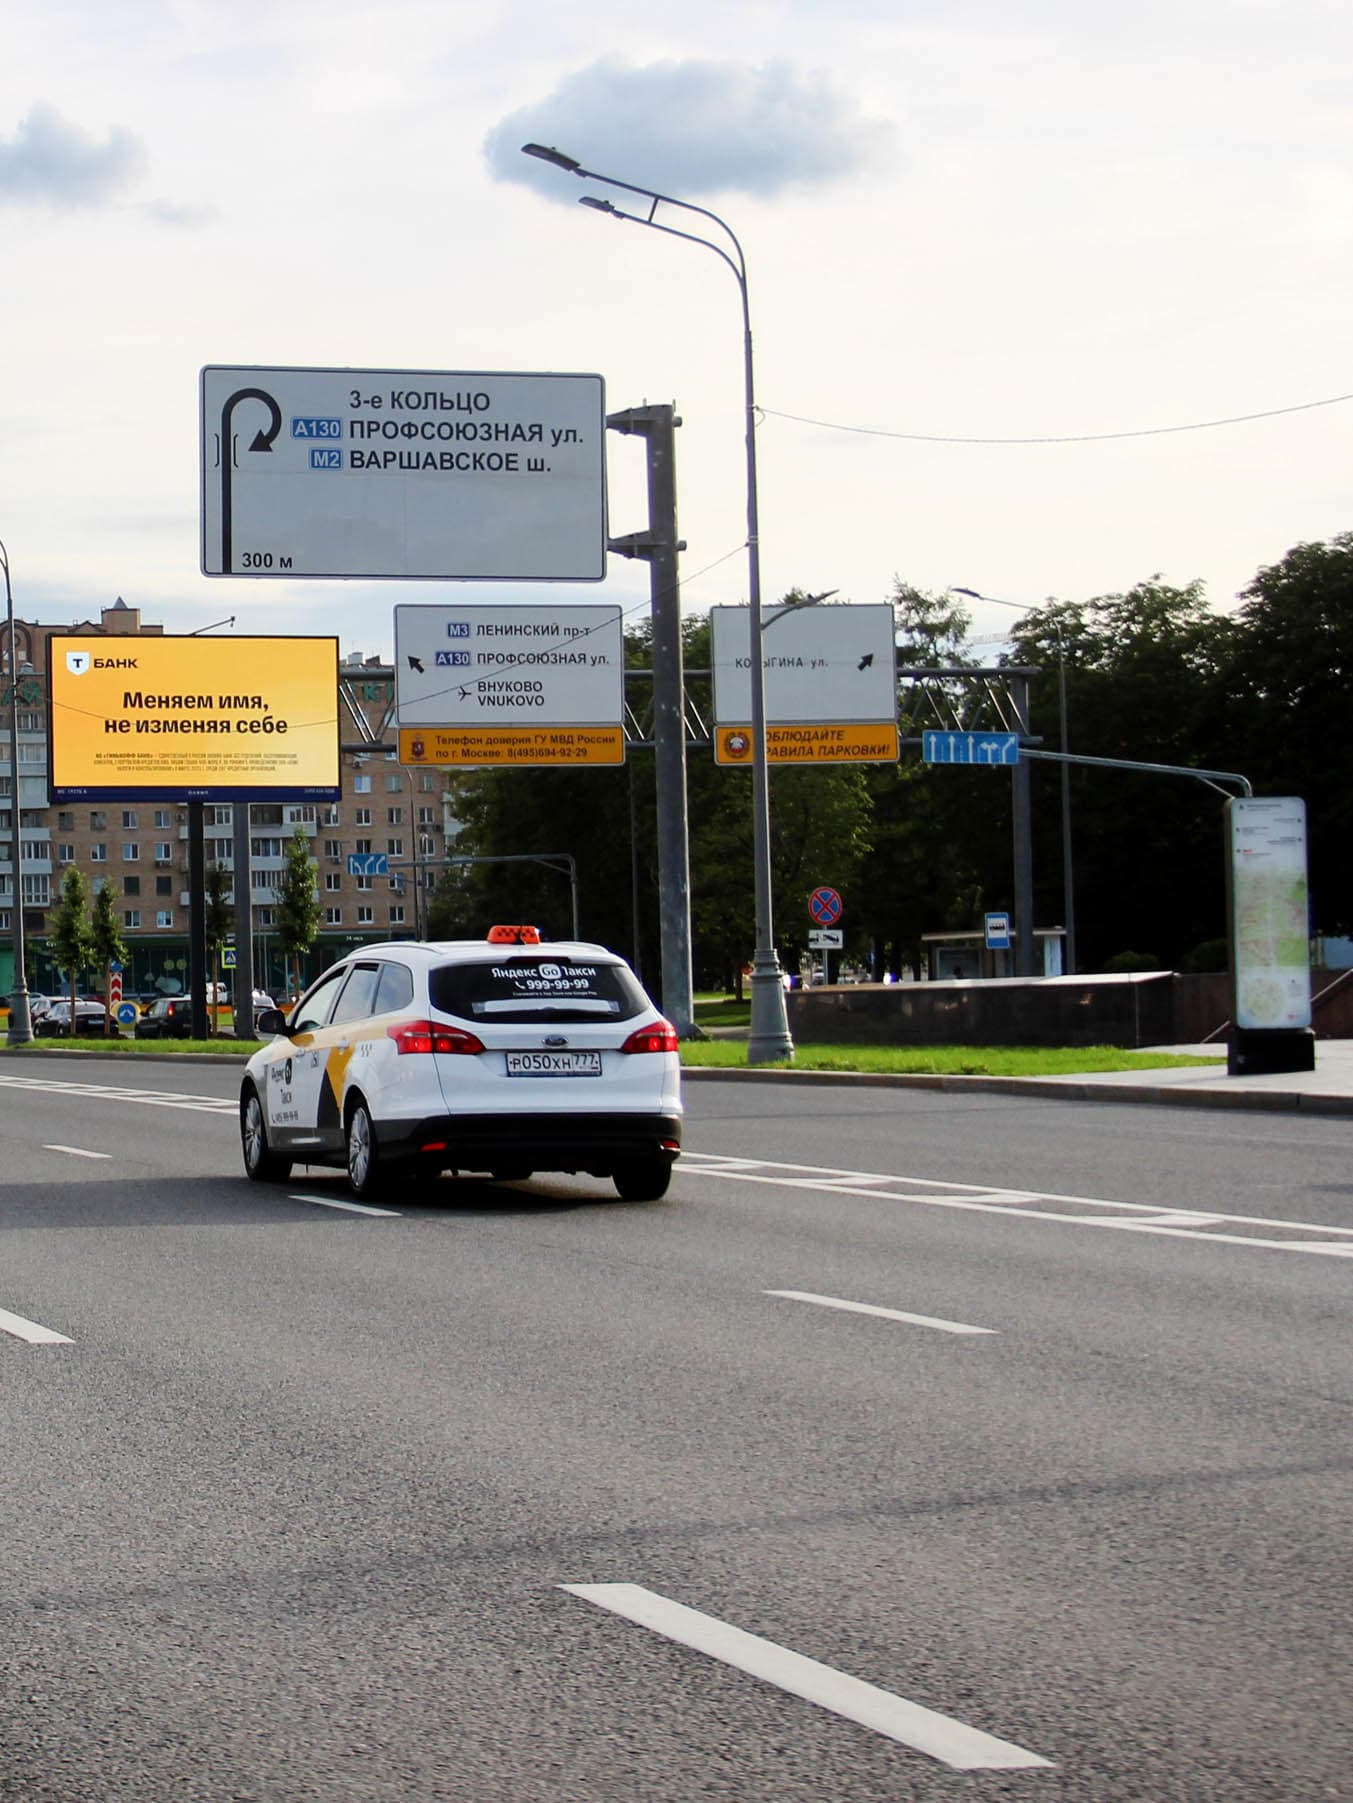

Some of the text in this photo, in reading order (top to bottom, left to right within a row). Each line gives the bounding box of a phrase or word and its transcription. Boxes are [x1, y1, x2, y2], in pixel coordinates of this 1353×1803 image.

[349, 390, 490, 415] 3-е КОЛЬЦО
[349, 420, 543, 442] ПРОФСОЮЗНАЯ
[550, 427, 584, 447] ул.
[350, 450, 519, 471] ВАРШАВСКОЕ
[527, 457, 552, 472] ш.
[241, 552, 293, 569] 300 м
[476, 622, 560, 637] ЛЕНИНСКИЙ
[563, 627, 591, 639] пр-т
[93, 657, 139, 669] БАНК
[476, 652, 587, 665] ПРОФСОЮЗНАЯ
[590, 656, 610, 668] ул.
[735, 656, 829, 670] КОЫГИНА ул.
[477, 680, 543, 693] ВНУКОВО
[122, 691, 270, 712] Меняем имя,
[477, 694, 545, 707] VNUKOVO
[104, 715, 288, 734] не изменяя себе
[435, 734, 616, 746] Телефон доверия ГУ МВД России
[766, 729, 845, 743] ОБЛЮДАЙТЕ
[435, 750, 449, 759] по
[766, 744, 814, 757] РАВИЛА
[491, 967, 538, 979] Яндекс
[561, 965, 597, 977] Такси
[526, 978, 590, 990] 999-99-99
